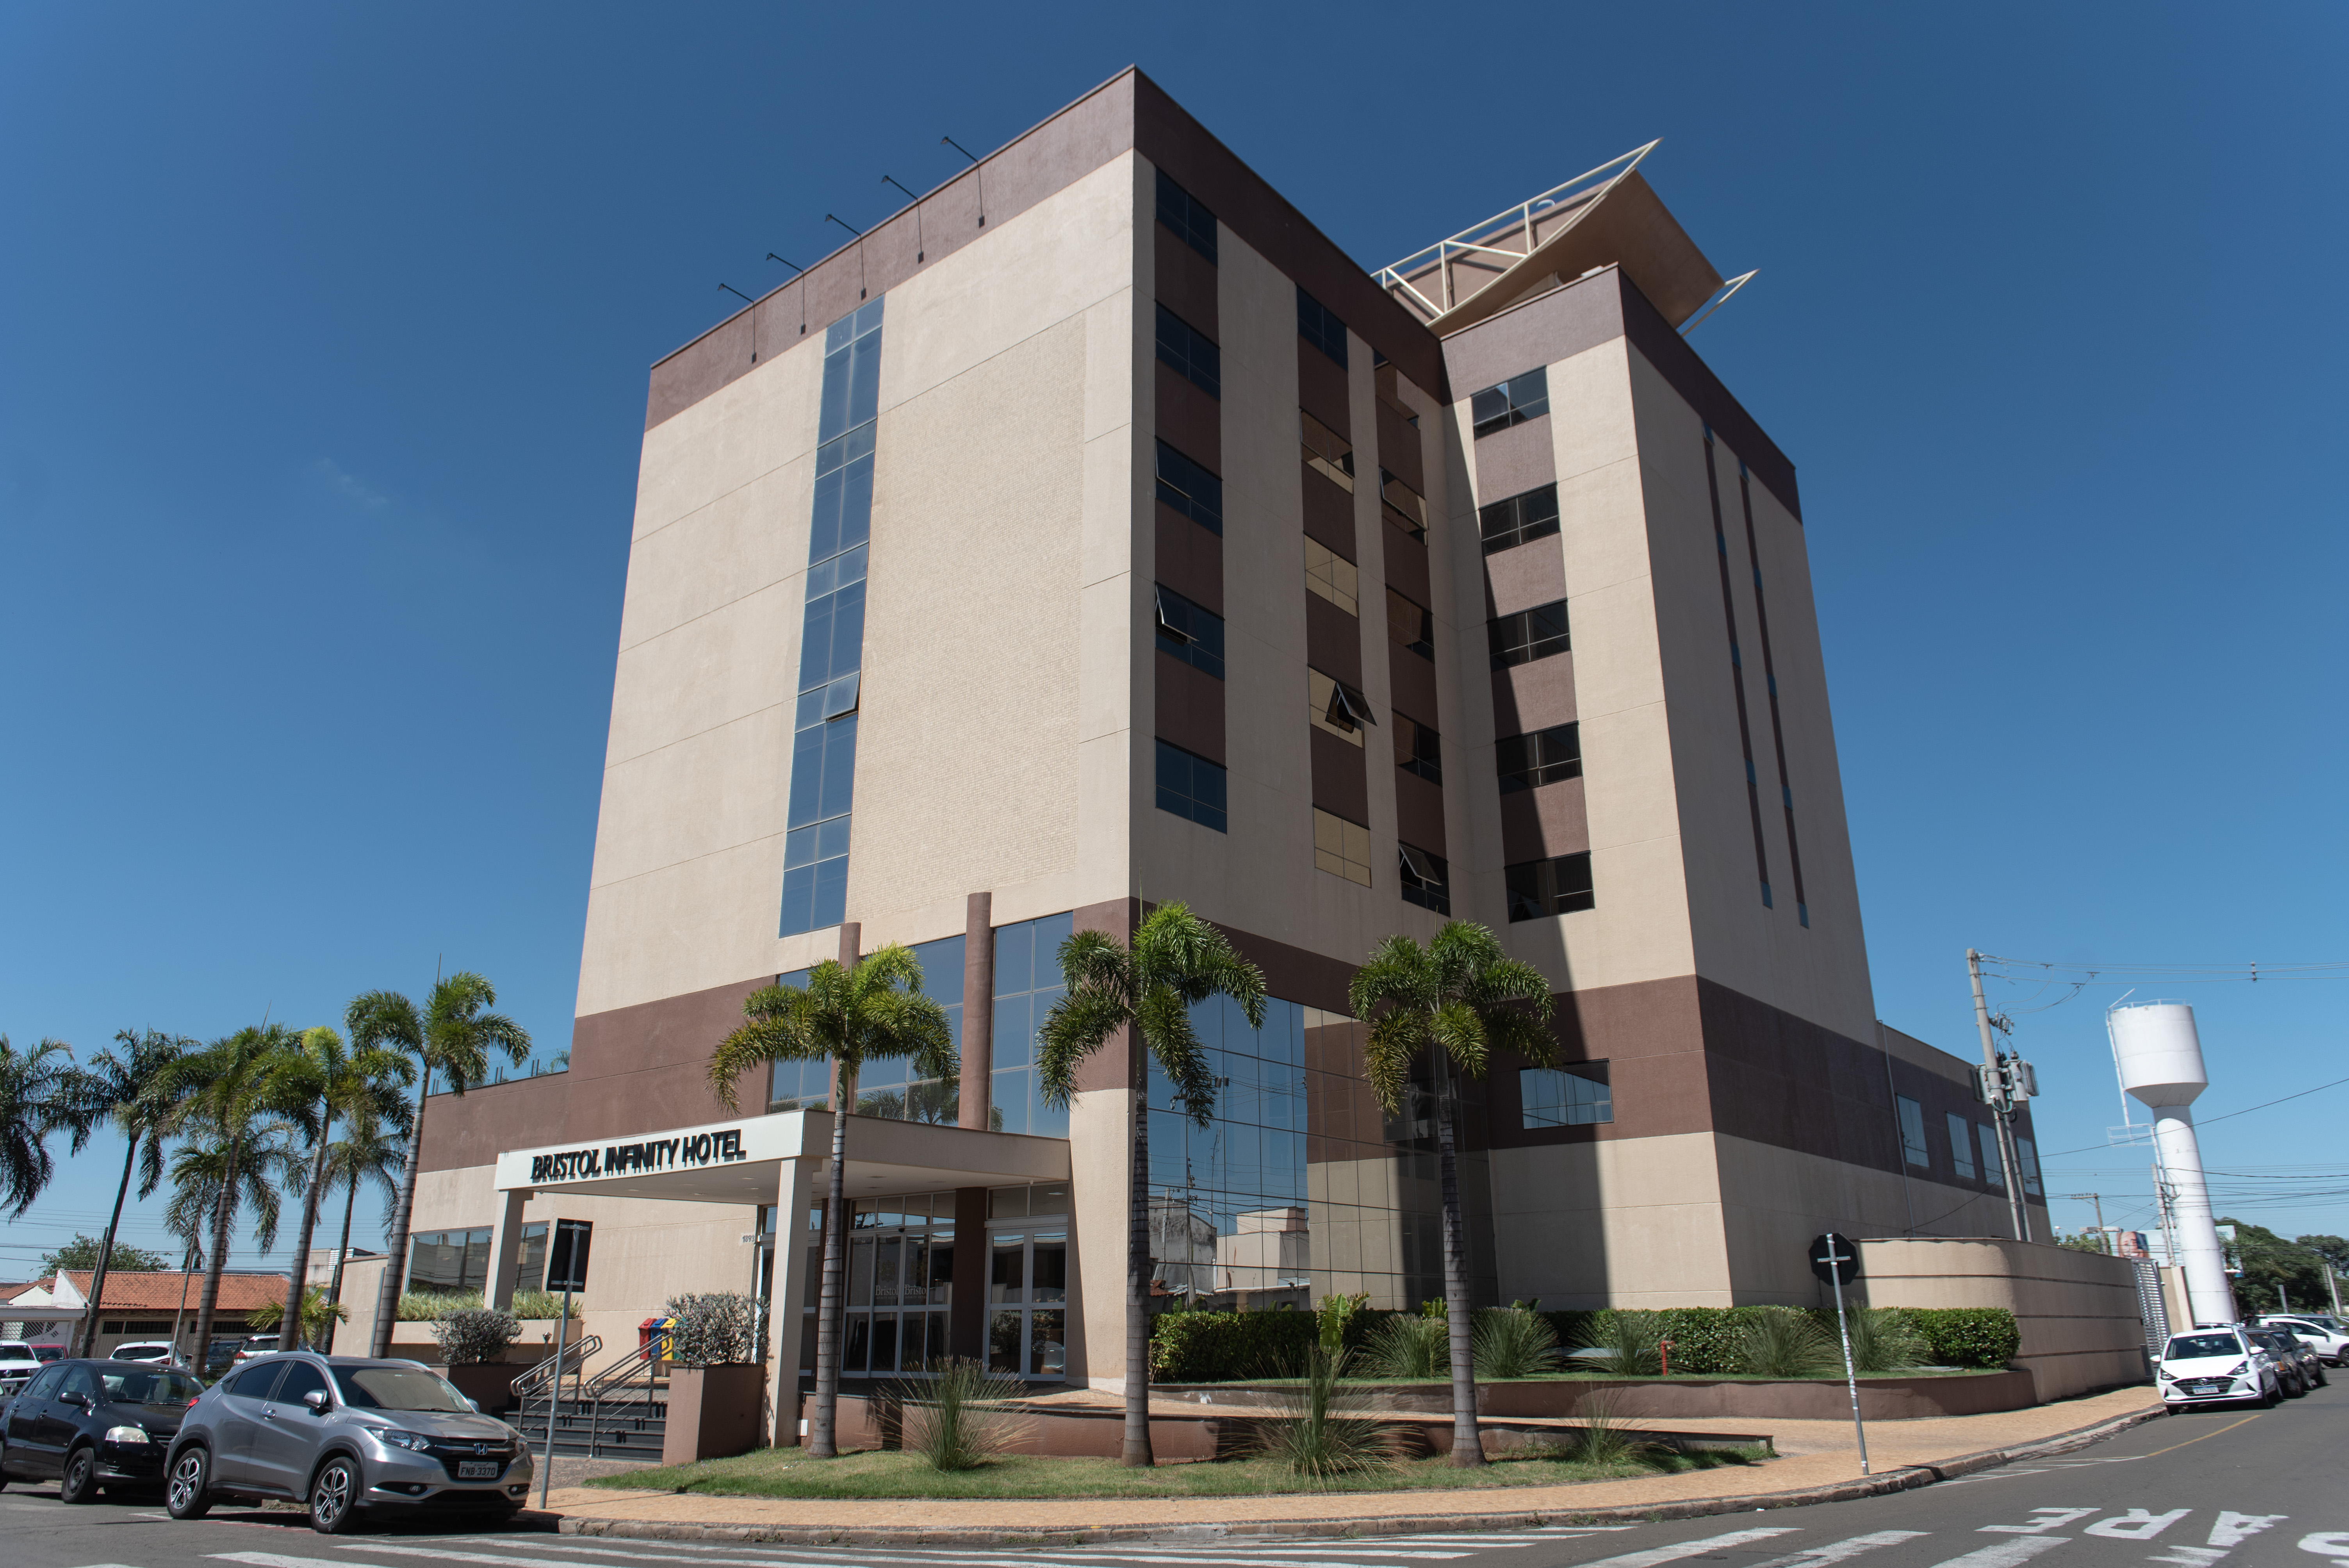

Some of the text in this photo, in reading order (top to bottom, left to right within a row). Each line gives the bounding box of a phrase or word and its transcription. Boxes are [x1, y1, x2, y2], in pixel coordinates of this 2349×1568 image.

[530, 1129, 747, 1180] BRISTOL INFINITY HOTEL
[875, 1284, 898, 1295] Bristol
